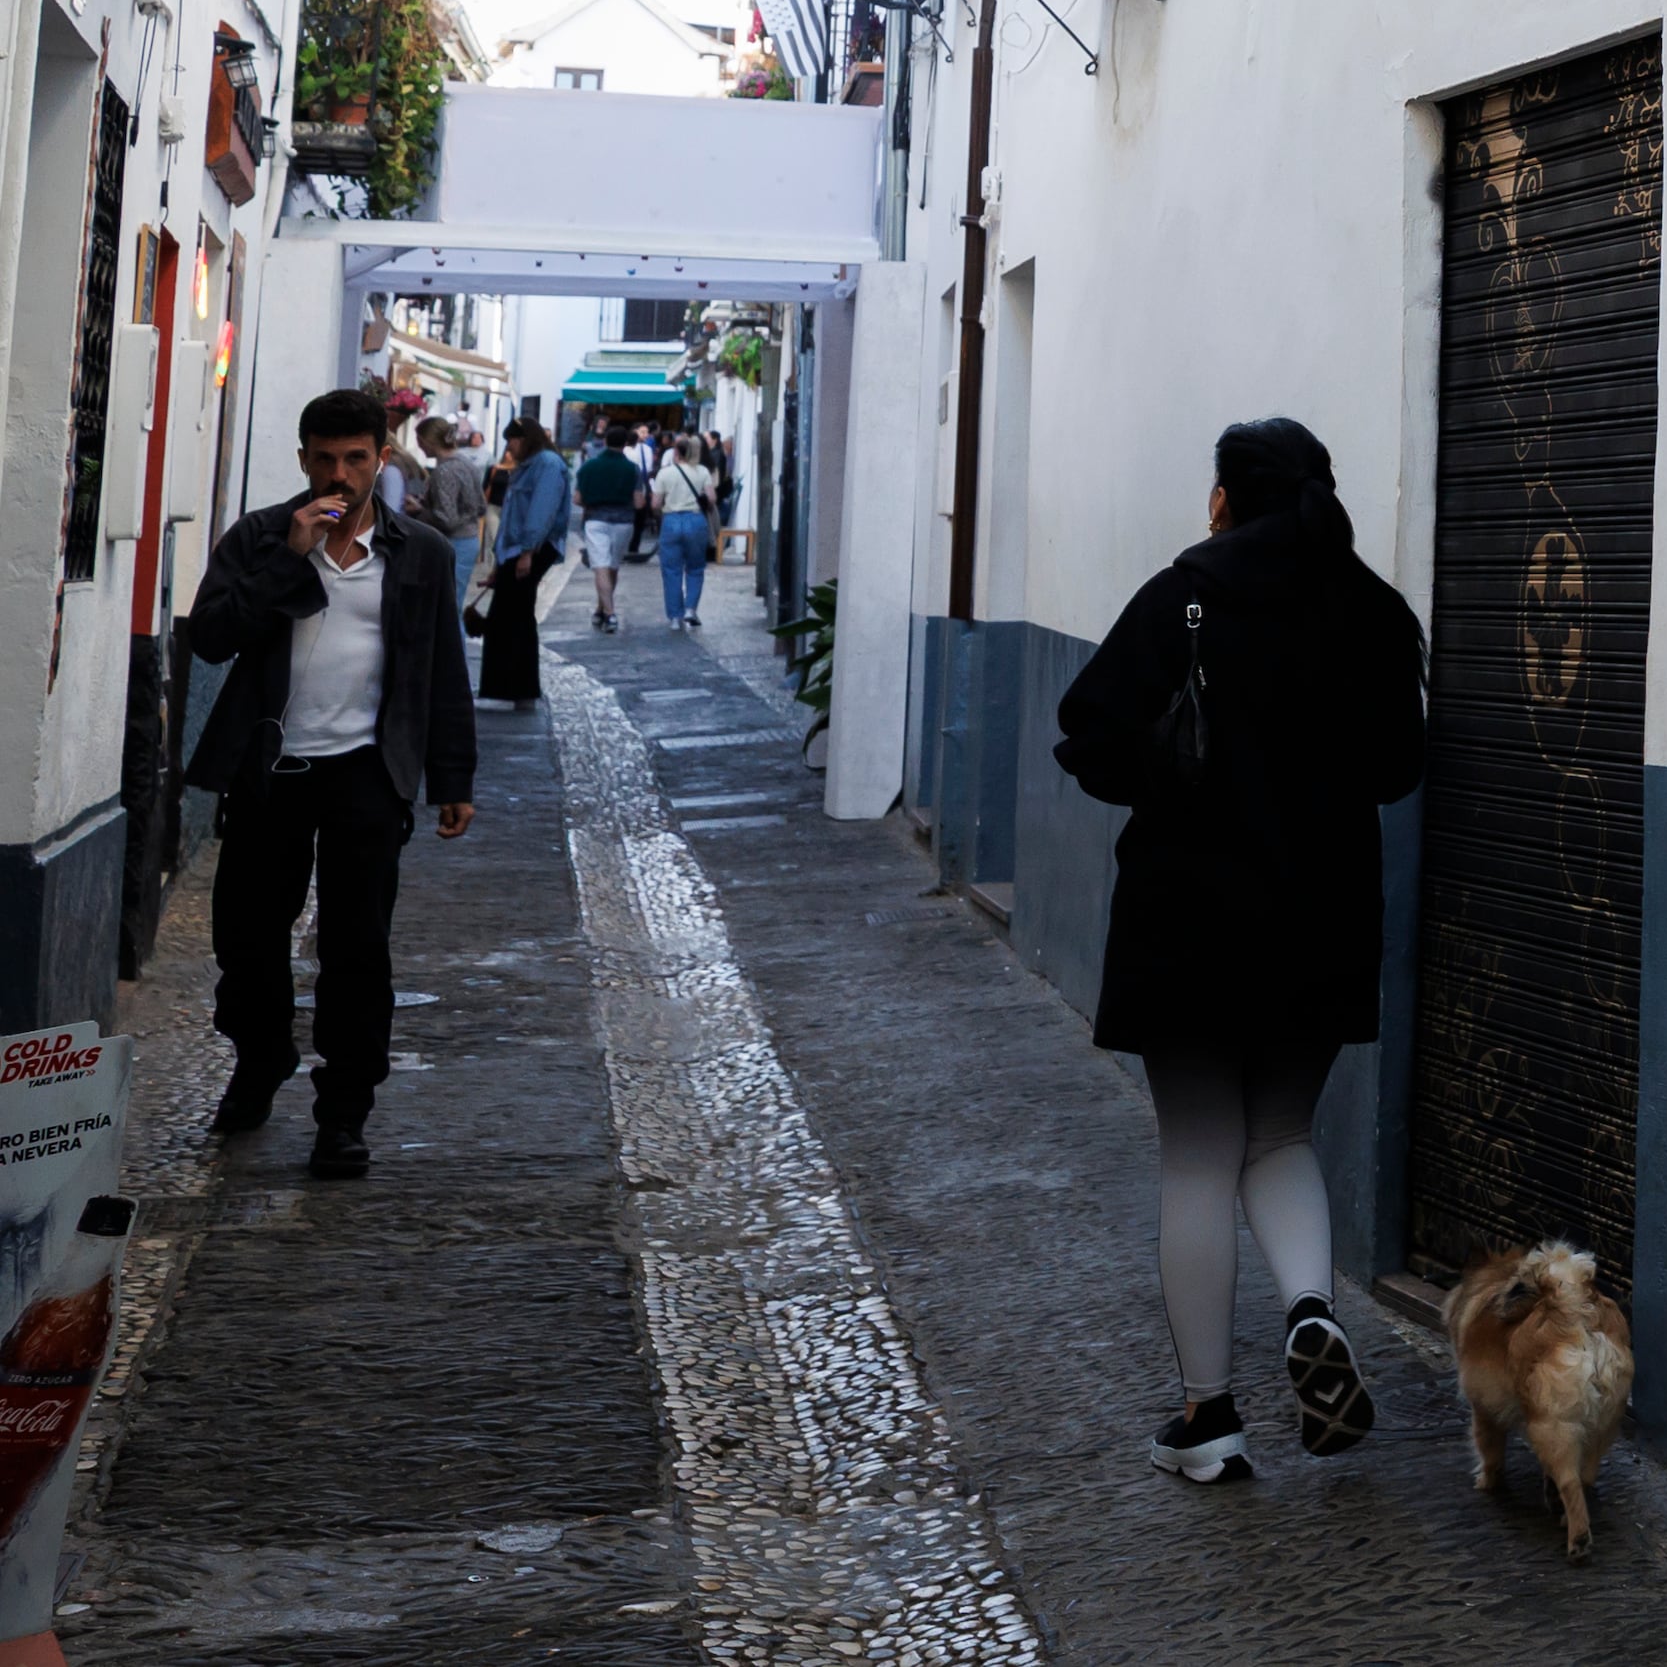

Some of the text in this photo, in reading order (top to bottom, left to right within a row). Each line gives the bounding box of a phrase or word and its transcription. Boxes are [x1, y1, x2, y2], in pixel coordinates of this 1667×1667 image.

[4, 1033, 73, 1063] COLD
[0, 1047, 103, 1084] DRINKS
[28, 1070, 87, 1089] TAKE AWAY
[28, 1123, 70, 1144] BIEN
[73, 1113, 112, 1134] FRÍA
[11, 1137, 82, 1164] NEVERA
[8, 1374, 32, 1384] ZERO
